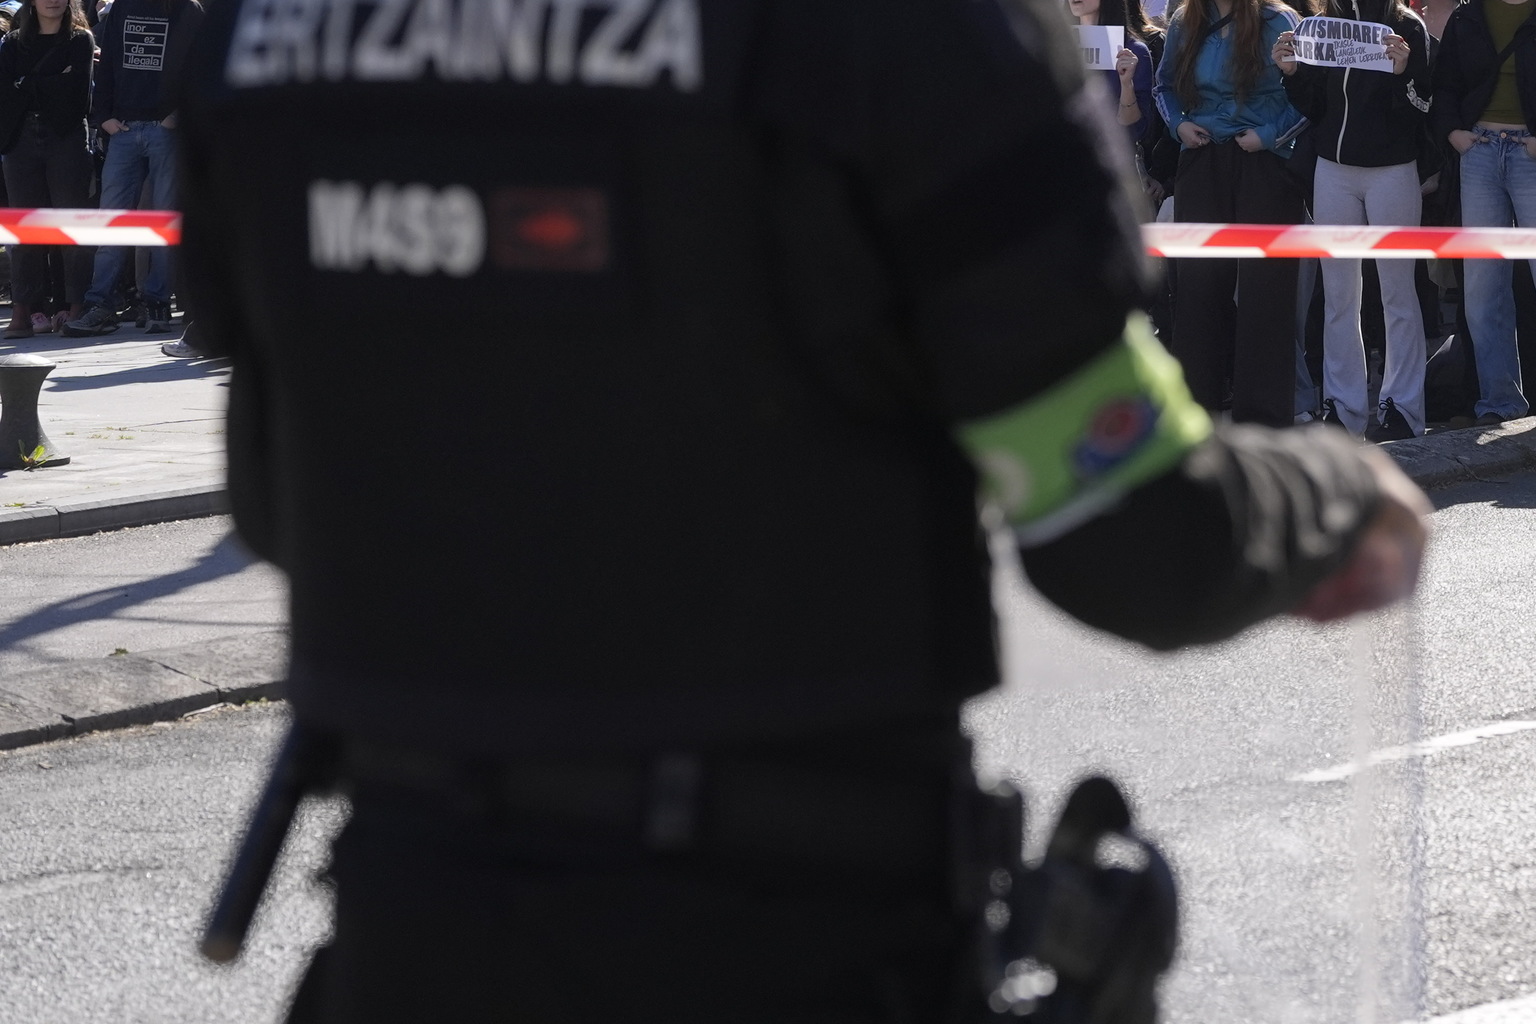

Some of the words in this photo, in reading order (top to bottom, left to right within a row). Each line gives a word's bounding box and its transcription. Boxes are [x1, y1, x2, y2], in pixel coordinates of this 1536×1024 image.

[127, 22, 146, 33] inor
[144, 36, 155, 44] ez
[131, 45, 145, 54] da
[1294, 39, 1336, 62] URKA
[128, 55, 160, 67] ilegala
